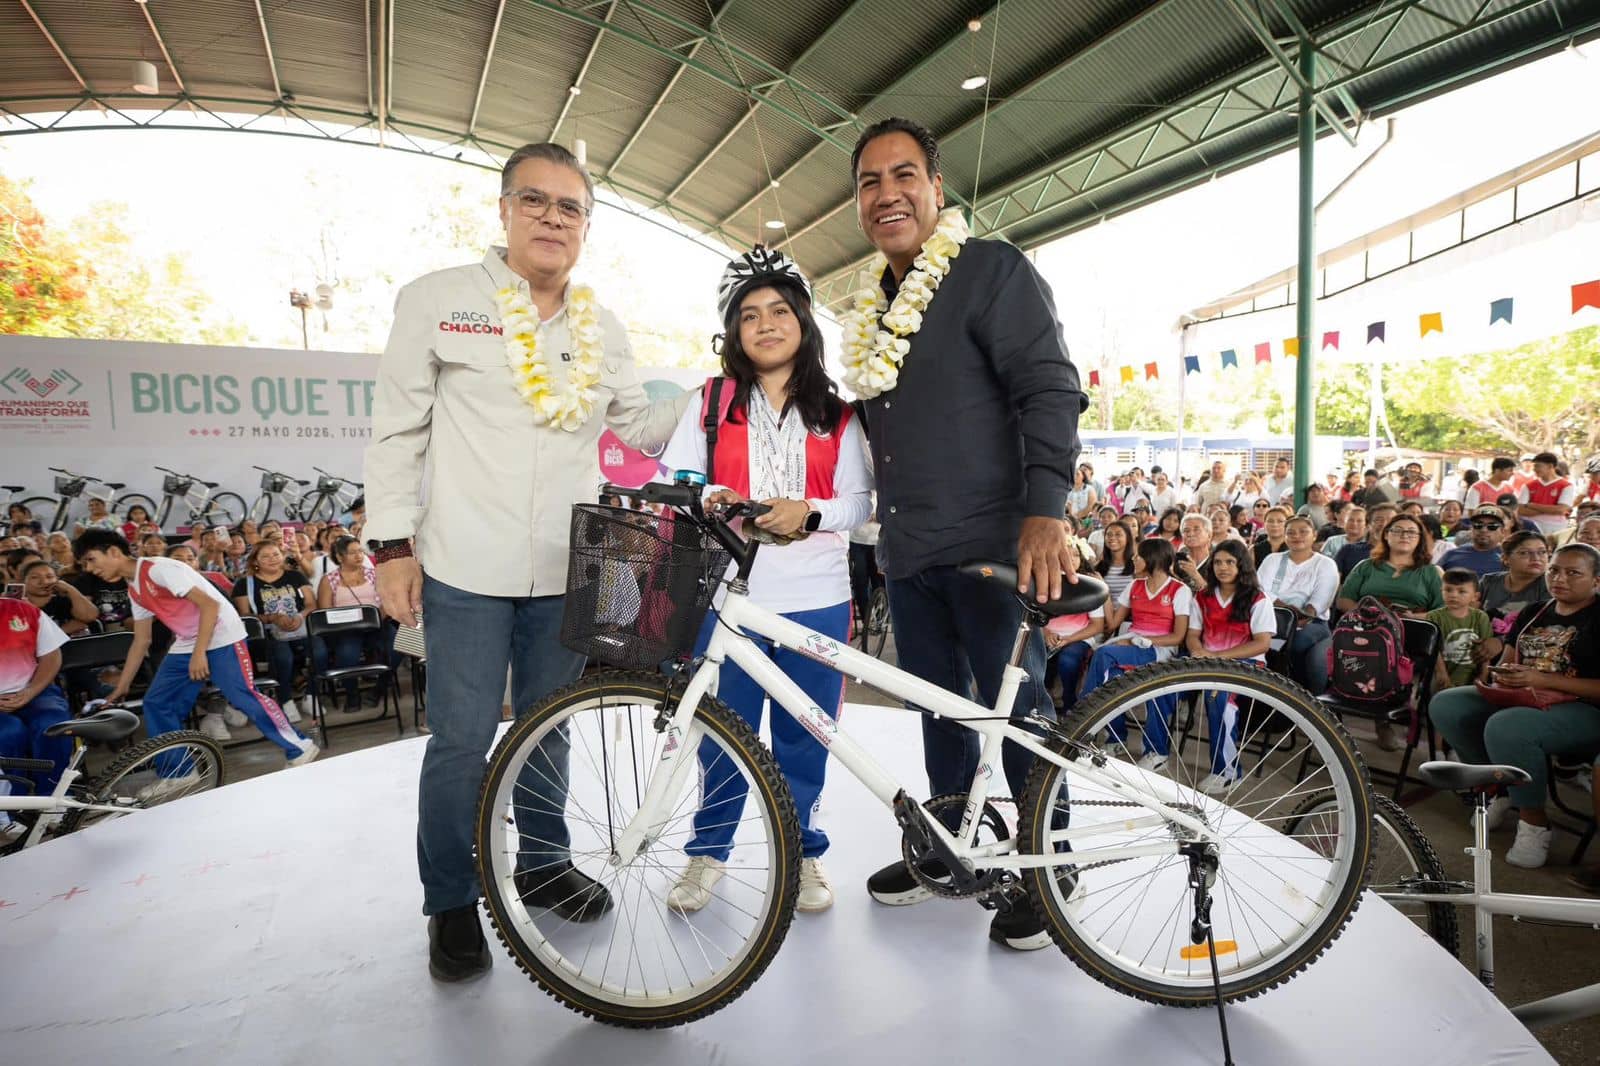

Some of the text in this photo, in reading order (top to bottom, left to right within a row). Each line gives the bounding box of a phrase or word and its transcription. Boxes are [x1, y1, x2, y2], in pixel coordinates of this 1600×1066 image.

[451, 311, 490, 324] PACO
[130, 372, 242, 415] BICIS
[250, 376, 330, 421] QUE
[0, 407, 90, 417] TRANSFORMA
[228, 426, 246, 438] 27
[252, 426, 290, 438] MAYO
